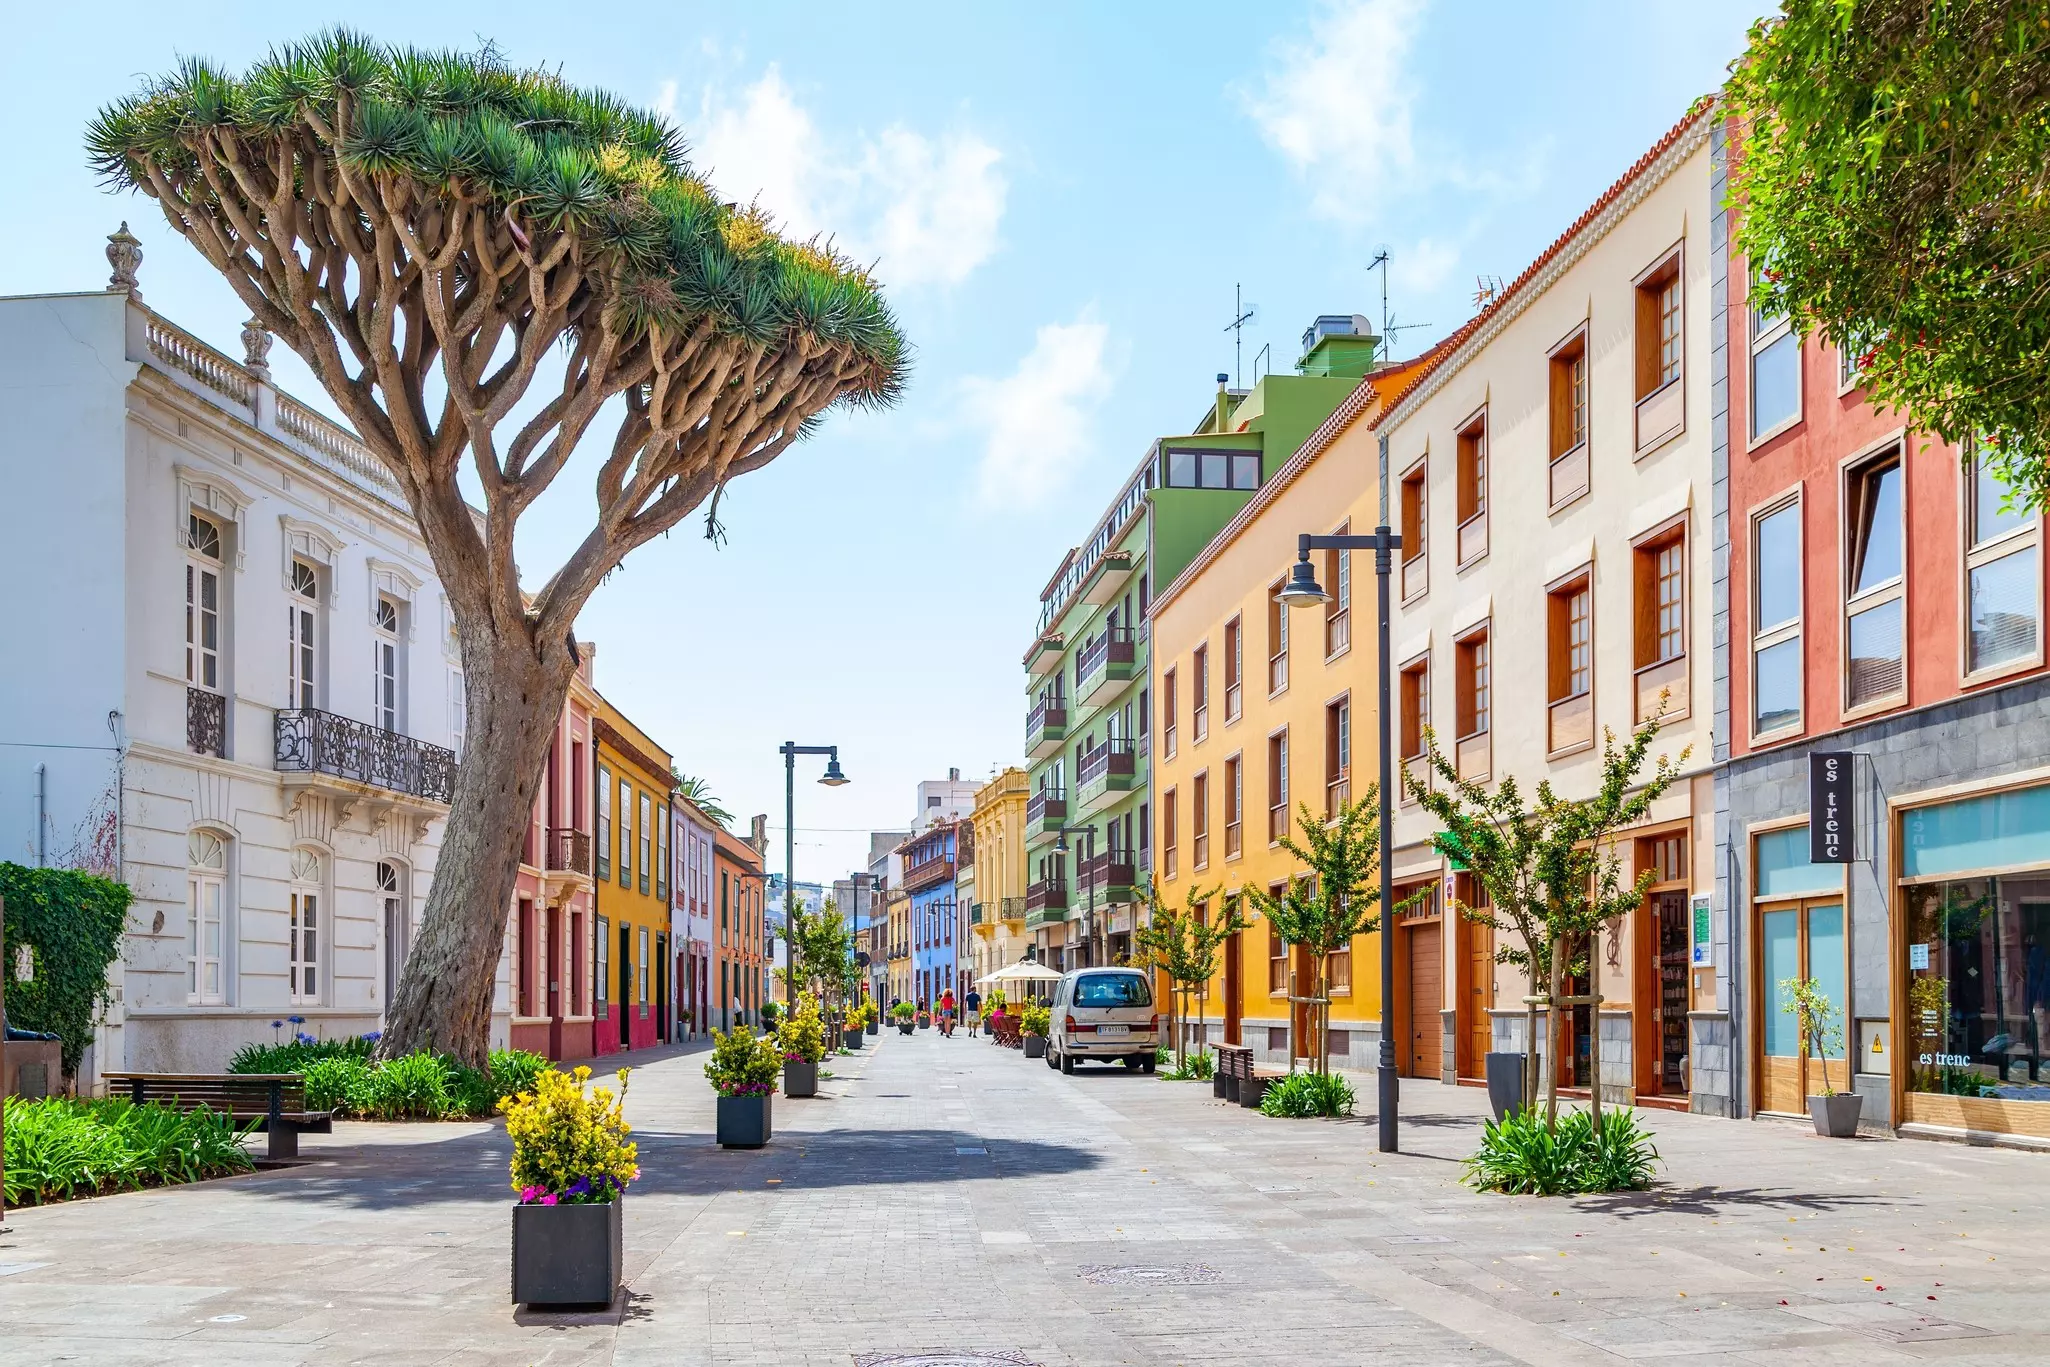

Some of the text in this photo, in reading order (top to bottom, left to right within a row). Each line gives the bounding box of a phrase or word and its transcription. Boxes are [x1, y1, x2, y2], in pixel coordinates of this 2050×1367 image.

[1825, 758, 1840, 858] es trenc
[1919, 1051, 1971, 1067] es trenc
